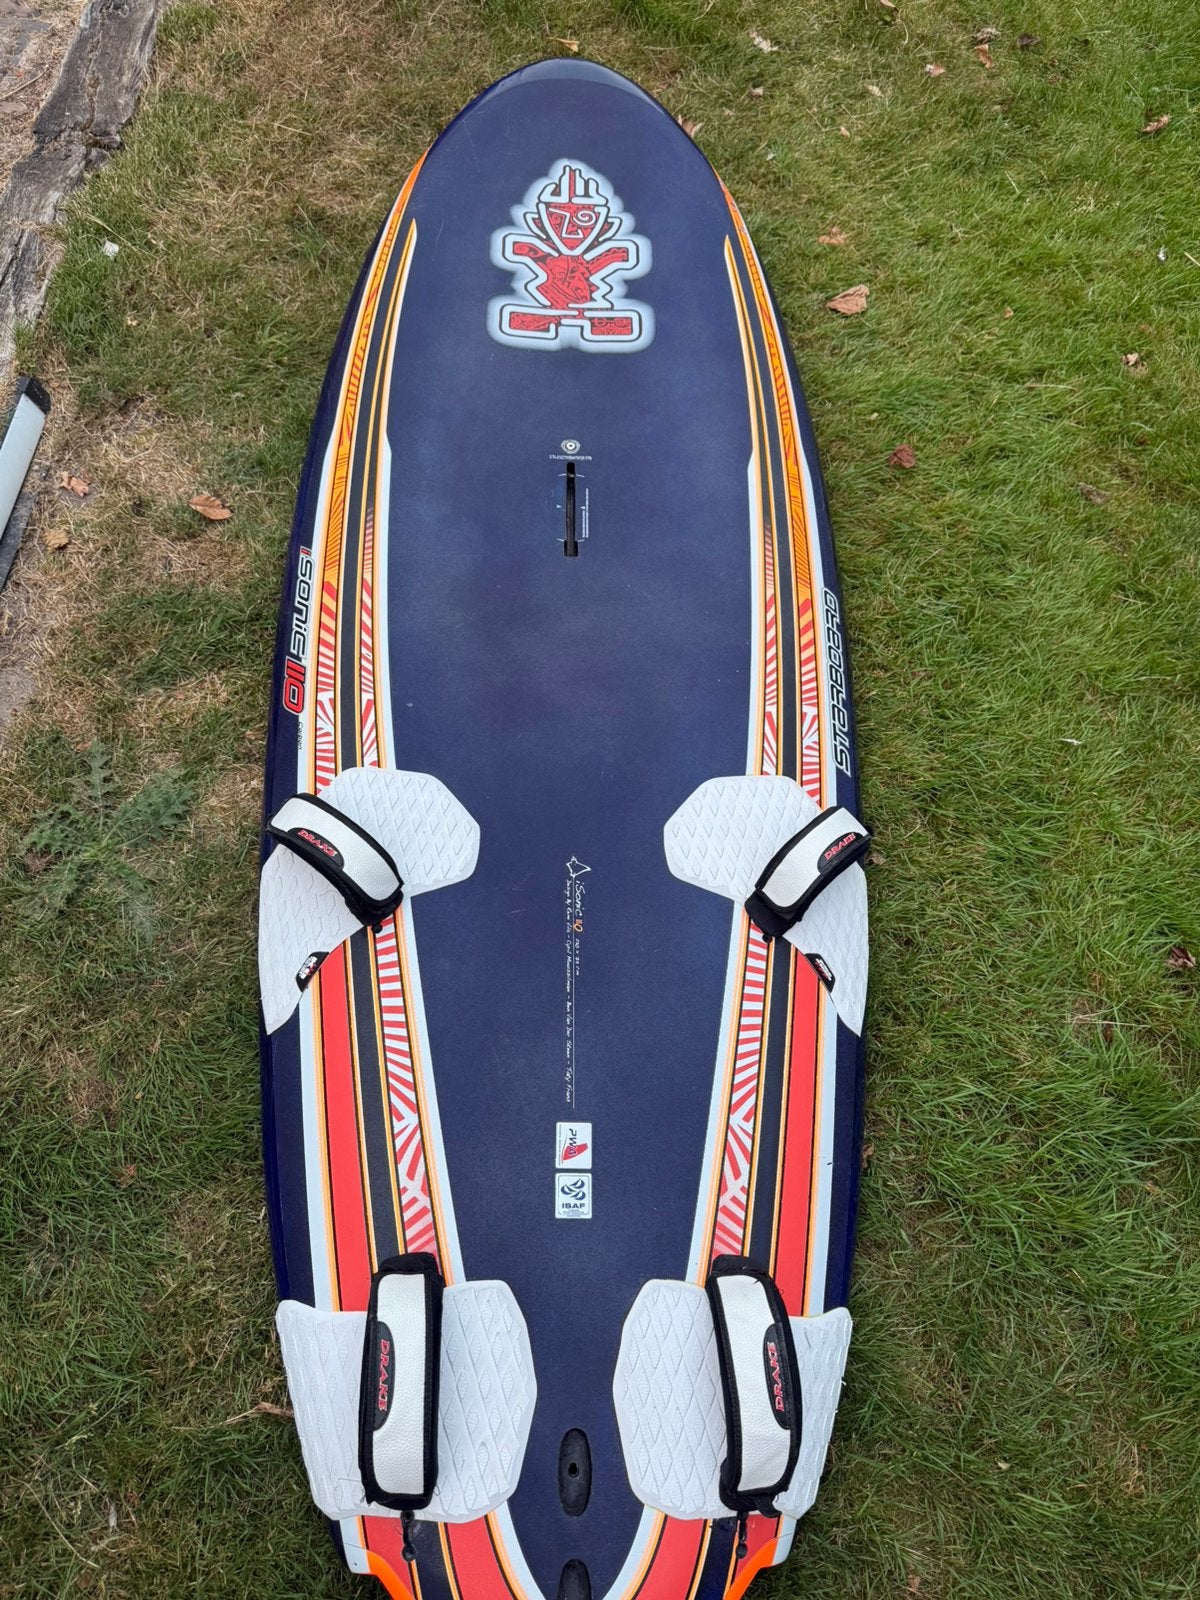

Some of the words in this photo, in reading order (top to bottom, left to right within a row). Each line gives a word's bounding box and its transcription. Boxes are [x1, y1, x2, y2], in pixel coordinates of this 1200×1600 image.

[282, 656, 306, 715] 110
[297, 829, 337, 857] DRAKE
[824, 833, 856, 860] DRAKE
[574, 880, 586, 917] iSonic
[568, 1128, 577, 1156] PWA
[378, 1339, 390, 1412] DRAKE
[767, 1341, 785, 1412] DRAKE
